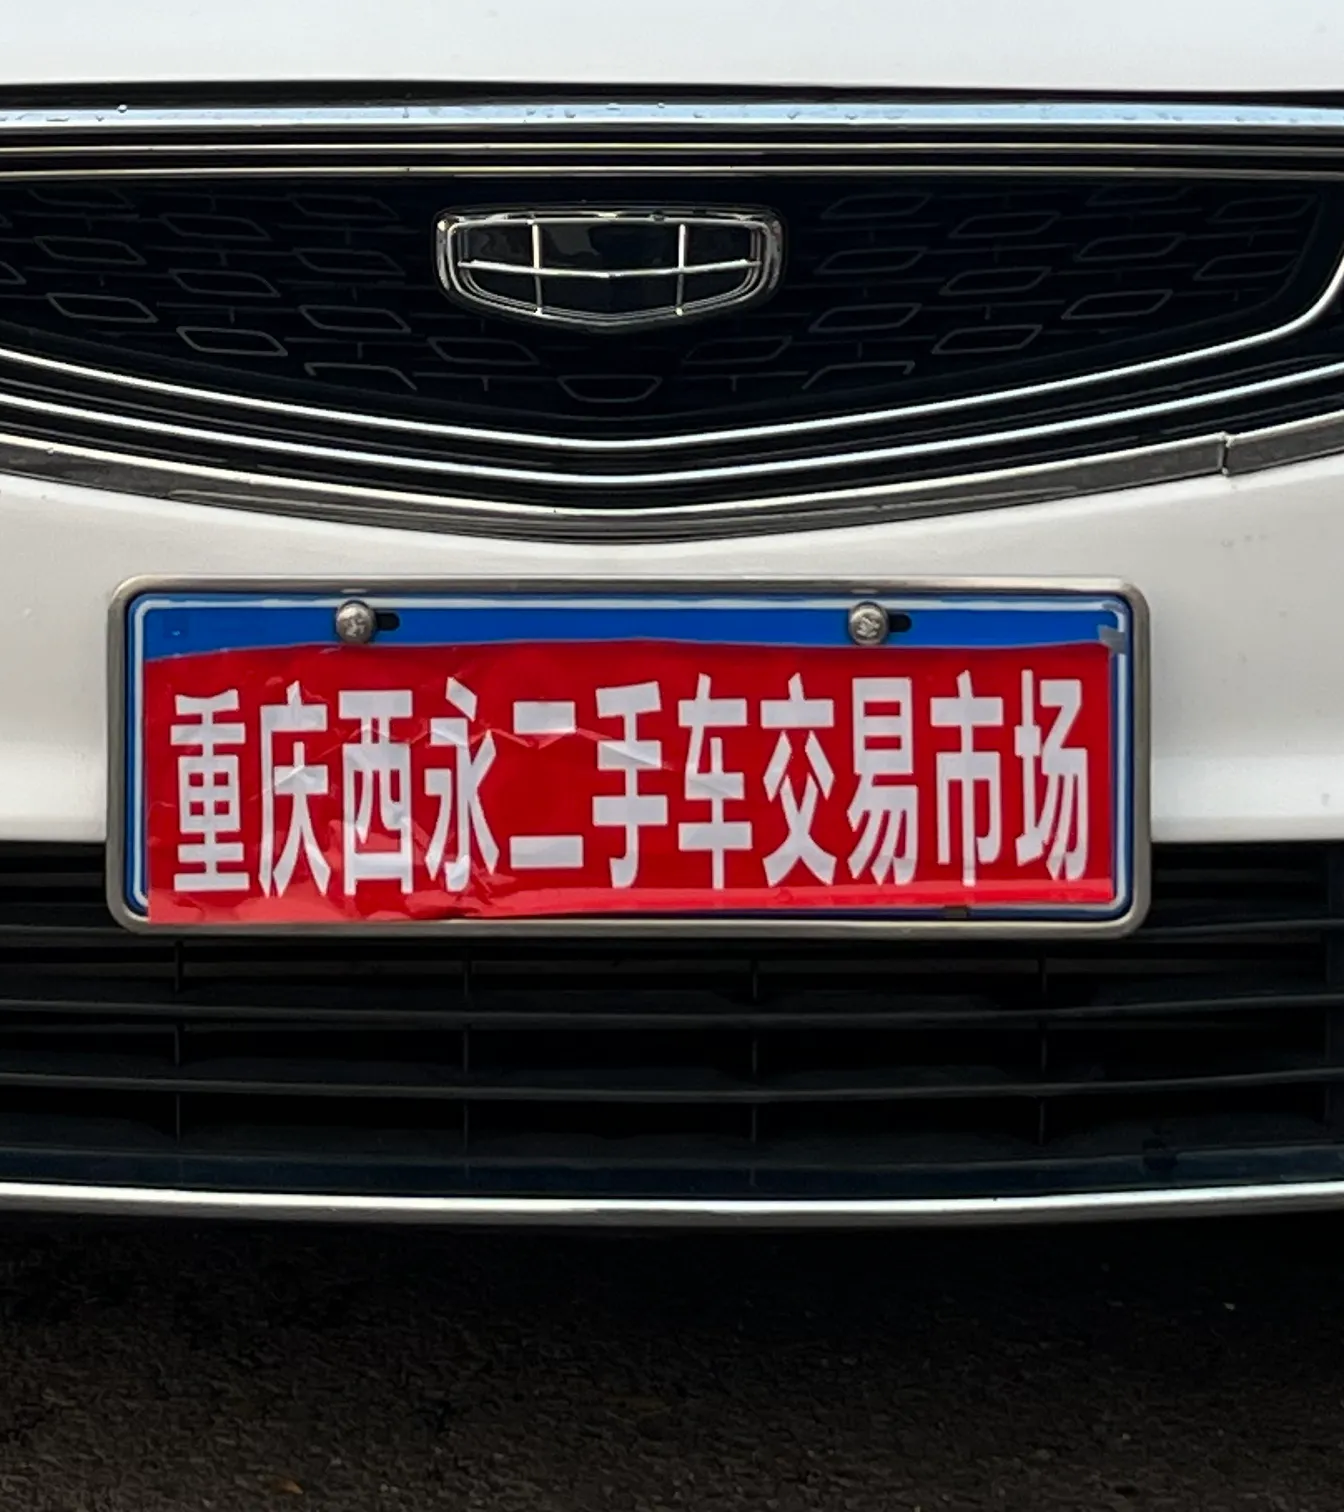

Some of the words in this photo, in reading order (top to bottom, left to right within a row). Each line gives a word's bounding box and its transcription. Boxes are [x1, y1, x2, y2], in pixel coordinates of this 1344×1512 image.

[170, 670, 1089, 898] 重庆西永二手车交易市场
